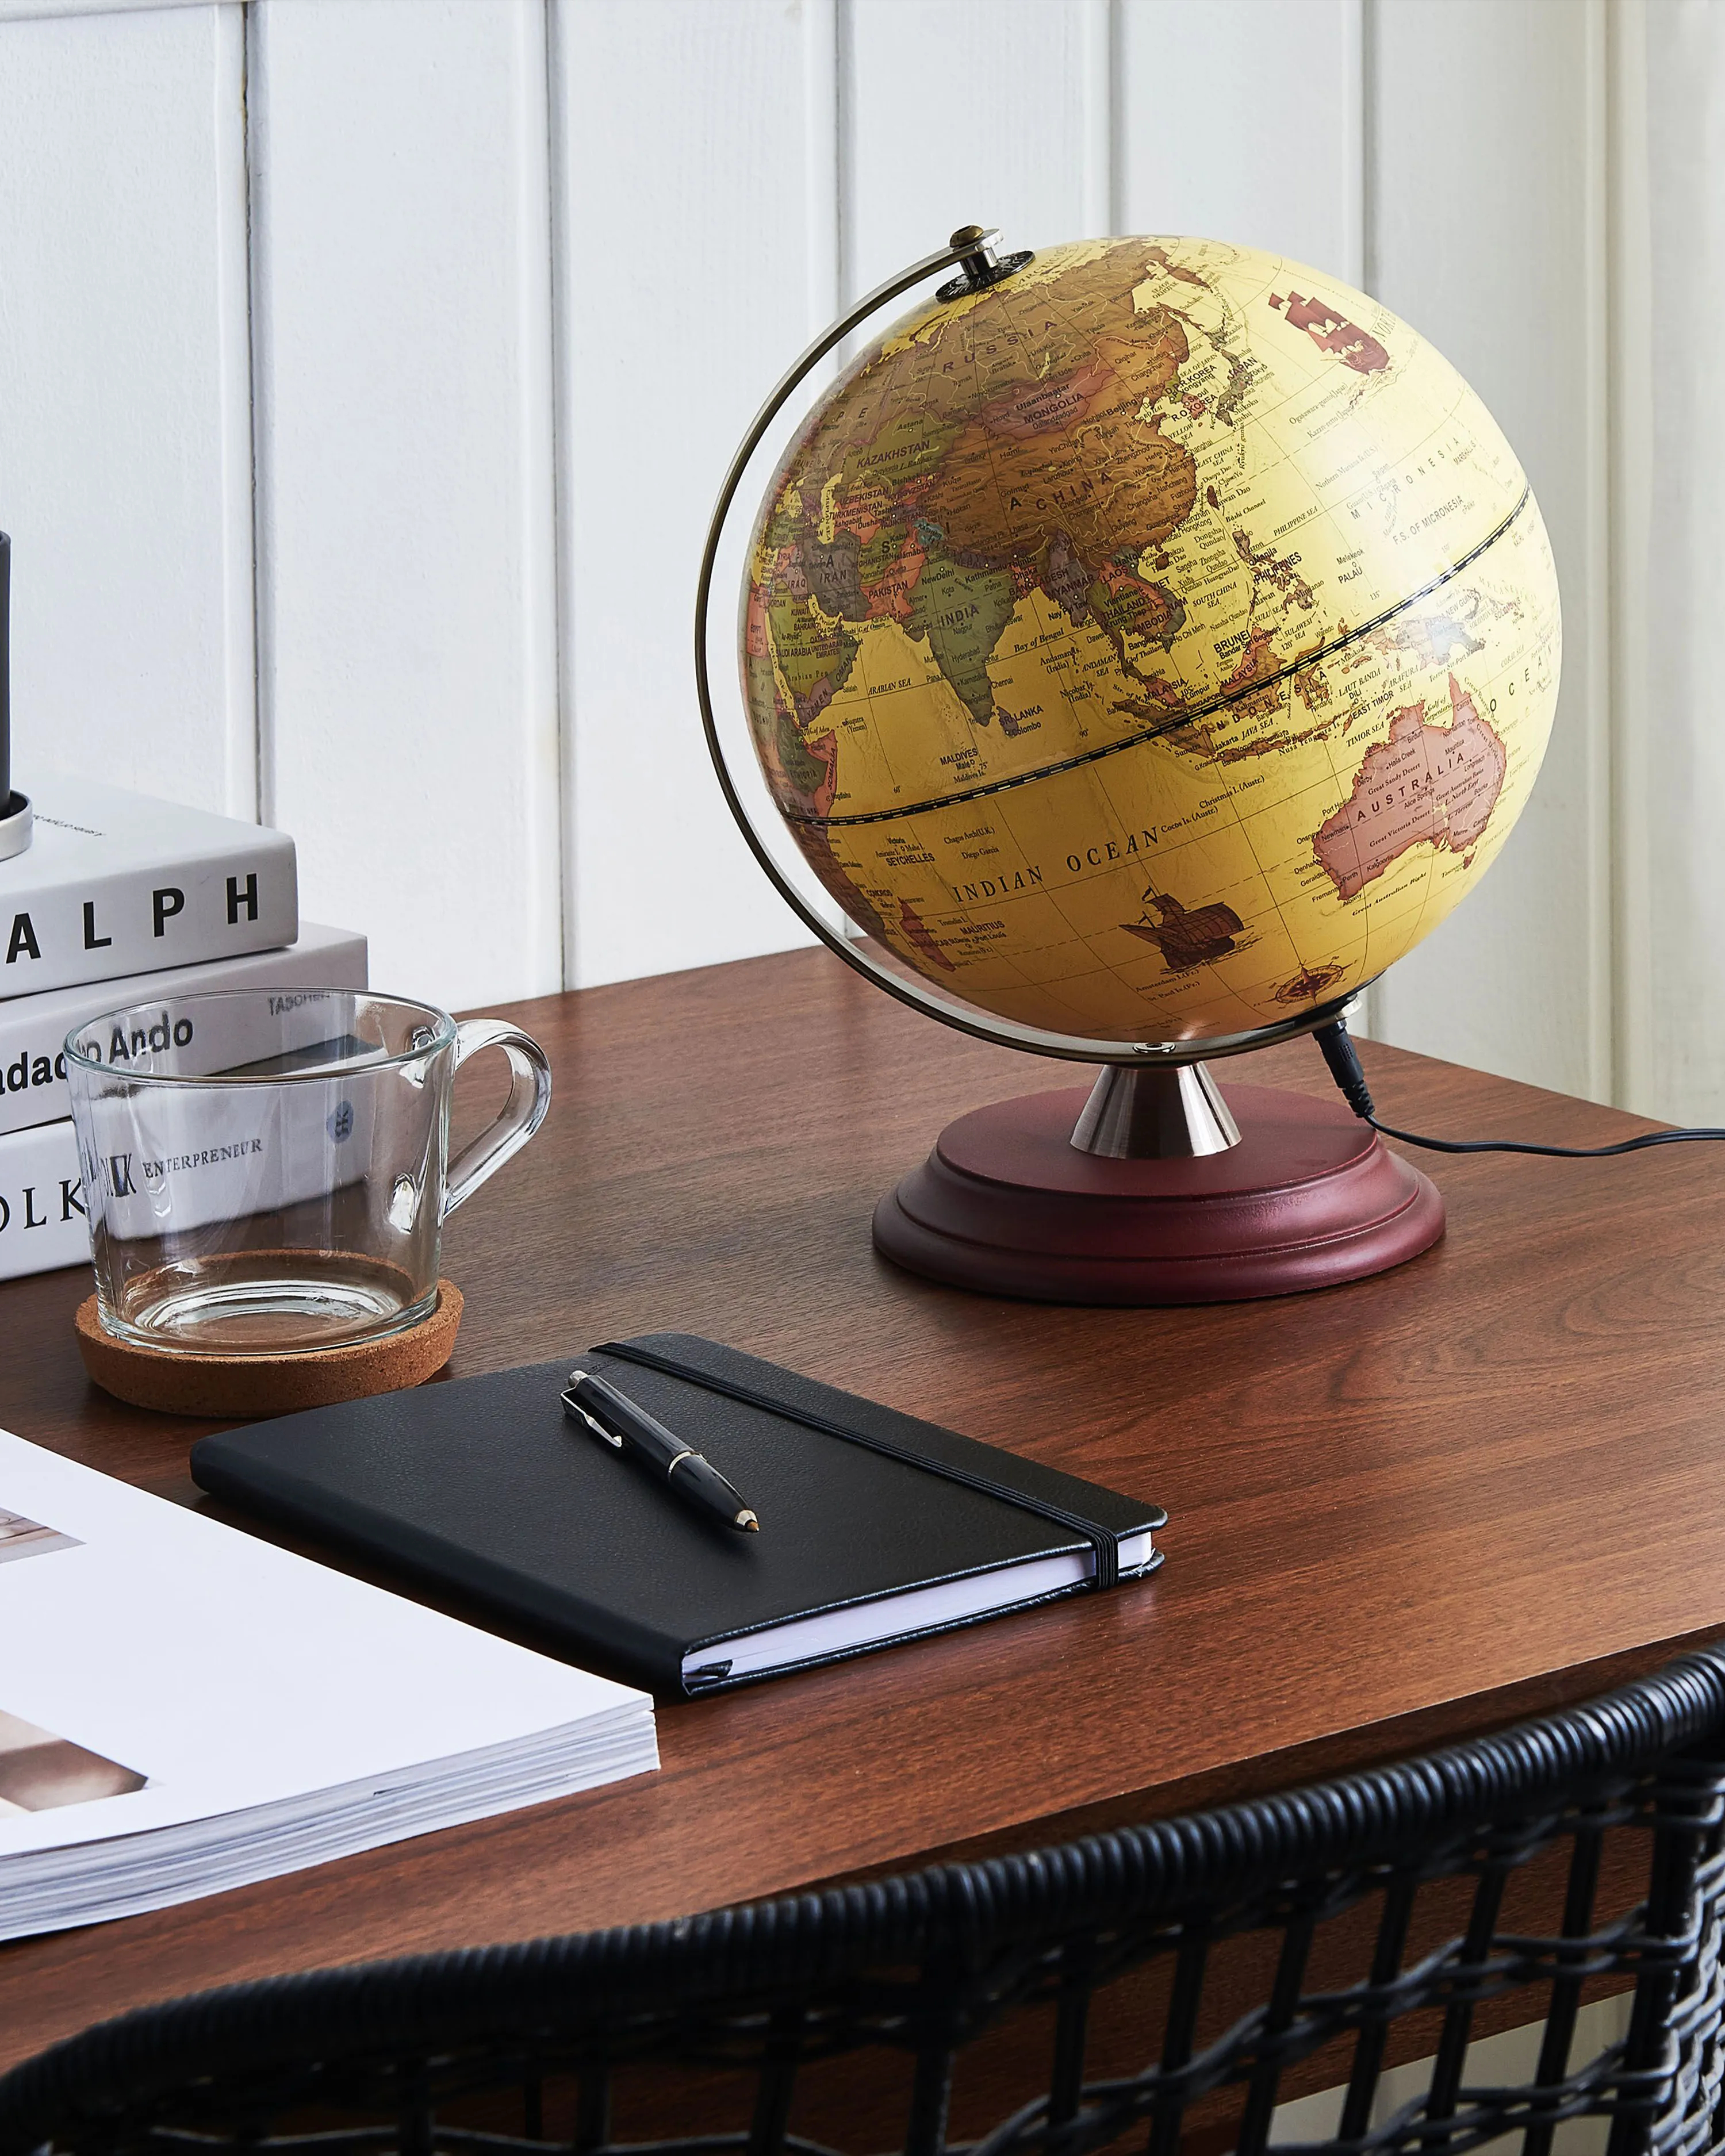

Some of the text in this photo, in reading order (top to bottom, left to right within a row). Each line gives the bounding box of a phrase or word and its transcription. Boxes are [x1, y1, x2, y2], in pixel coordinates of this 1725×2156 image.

[943, 321, 1057, 373] RUSSIA
[1228, 357, 1258, 379] JAPAN
[1015, 382, 1070, 412] Ulaanbaatar
[1023, 392, 1086, 424] MONGOLIA
[1106, 398, 1138, 416] Beijing
[898, 419, 923, 431] Astana
[1168, 423, 1194, 439] YELLOW
[1181, 433, 1194, 442] SEA
[856, 441, 930, 469] KAZAKHSTAN
[1198, 446, 1233, 468] EAST CHINA
[1213, 458, 1224, 467] SEA
[1036, 472, 1112, 509] CHINA
[1157, 476, 1187, 494] Nanchang
[838, 487, 888, 505] UZBEKISTAN
[1128, 494, 1157, 511] Changsha
[829, 501, 882, 520] TURKMENISTAN
[1410, 525, 1421, 535] OF
[1421, 496, 1463, 528] MICRONESIA
[1273, 506, 1318, 536] PHILIPPINE SEA
[1194, 527, 1222, 543] Dongsha
[1199, 549, 1226, 566] Zhongsha
[1206, 560, 1228, 573] Qundao
[965, 562, 1007, 584] Kathmandu
[1102, 566, 1128, 583] LAOS
[1254, 551, 1302, 584] PHILIPPINES
[1339, 567, 1363, 584] PALAU
[820, 571, 846, 584] IRAN
[868, 580, 908, 599] PAKISTAN
[1193, 582, 1237, 607] SOUTH CHINA
[1207, 599, 1220, 608] SEA
[941, 604, 979, 627] INDIA
[1125, 611, 1173, 636] CAMBODIA
[1285, 619, 1312, 637] SULAWESI
[1295, 631, 1306, 639] SEA
[1014, 628, 1064, 652] Bay of Bengal
[1213, 630, 1250, 653] BRUNEI
[952, 648, 980, 662] Hyderabad
[1220, 646, 1241, 660] Bandar
[835, 654, 852, 682] OMAN
[1046, 662, 1069, 674] (India)
[1082, 655, 1116, 672] ANDAMAN
[1097, 667, 1109, 676] SEA
[1222, 659, 1258, 686] MALAYSIA
[868, 678, 911, 695] ARABIAN SEA
[992, 677, 1013, 689] Chennai
[1144, 678, 1186, 701] MALAYSIA
[1339, 670, 1381, 696] LAUT BANDA
[1068, 692, 1091, 703] (India)
[1350, 690, 1362, 699] DILI
[1015, 705, 1044, 722] LANKA
[1352, 690, 1394, 719] EAST TIMOR
[1241, 719, 1273, 741] JAVA SEA
[1346, 722, 1385, 747] TIMOR SEA
[1216, 735, 1239, 750] Jakarta
[940, 748, 977, 765] MALDIVES
[1357, 752, 1463, 821] AUSTRALIA
[1368, 763, 1421, 795] Great Sandy Desert
[1199, 776, 1264, 809] Christmas (Austr.)
[1404, 799, 1417, 809] Alice
[1161, 806, 1218, 833] Cocos (Austr.)
[1370, 811, 1431, 847] Great Victoria Desert
[886, 853, 935, 866] SEYCHELLES
[953, 827, 1159, 903] INDIAN OCEAN
[1343, 871, 1358, 883] Perth
[960, 921, 1005, 935] MAURITIUS
[109, 1010, 194, 1064] Ando
